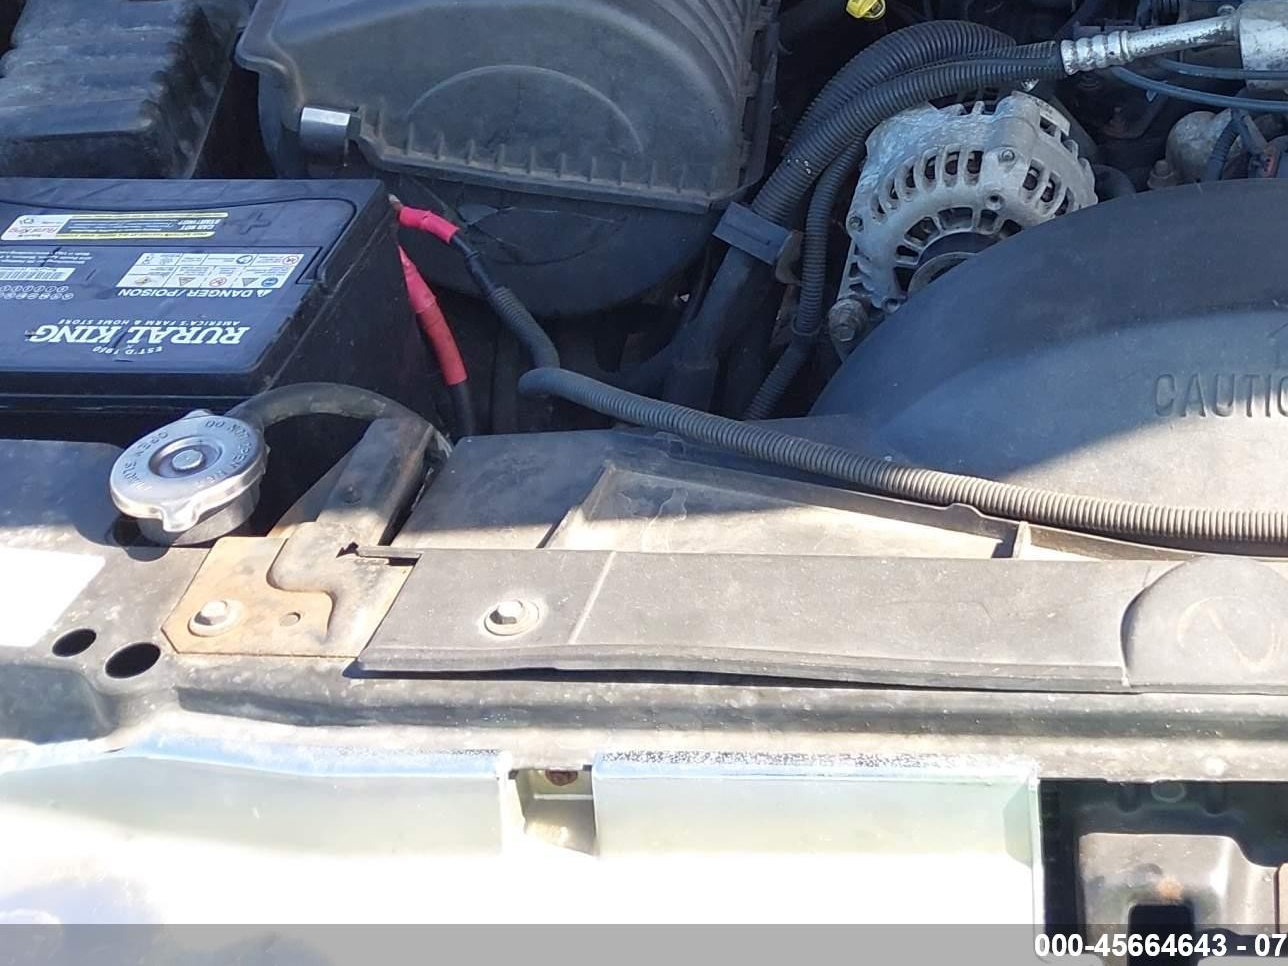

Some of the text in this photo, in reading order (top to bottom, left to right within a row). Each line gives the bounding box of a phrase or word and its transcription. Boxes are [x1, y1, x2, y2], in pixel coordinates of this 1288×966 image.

[29, 325, 250, 344] RURAL KING
[205, 419, 225, 429] DO
[135, 431, 169, 457] OPEN
